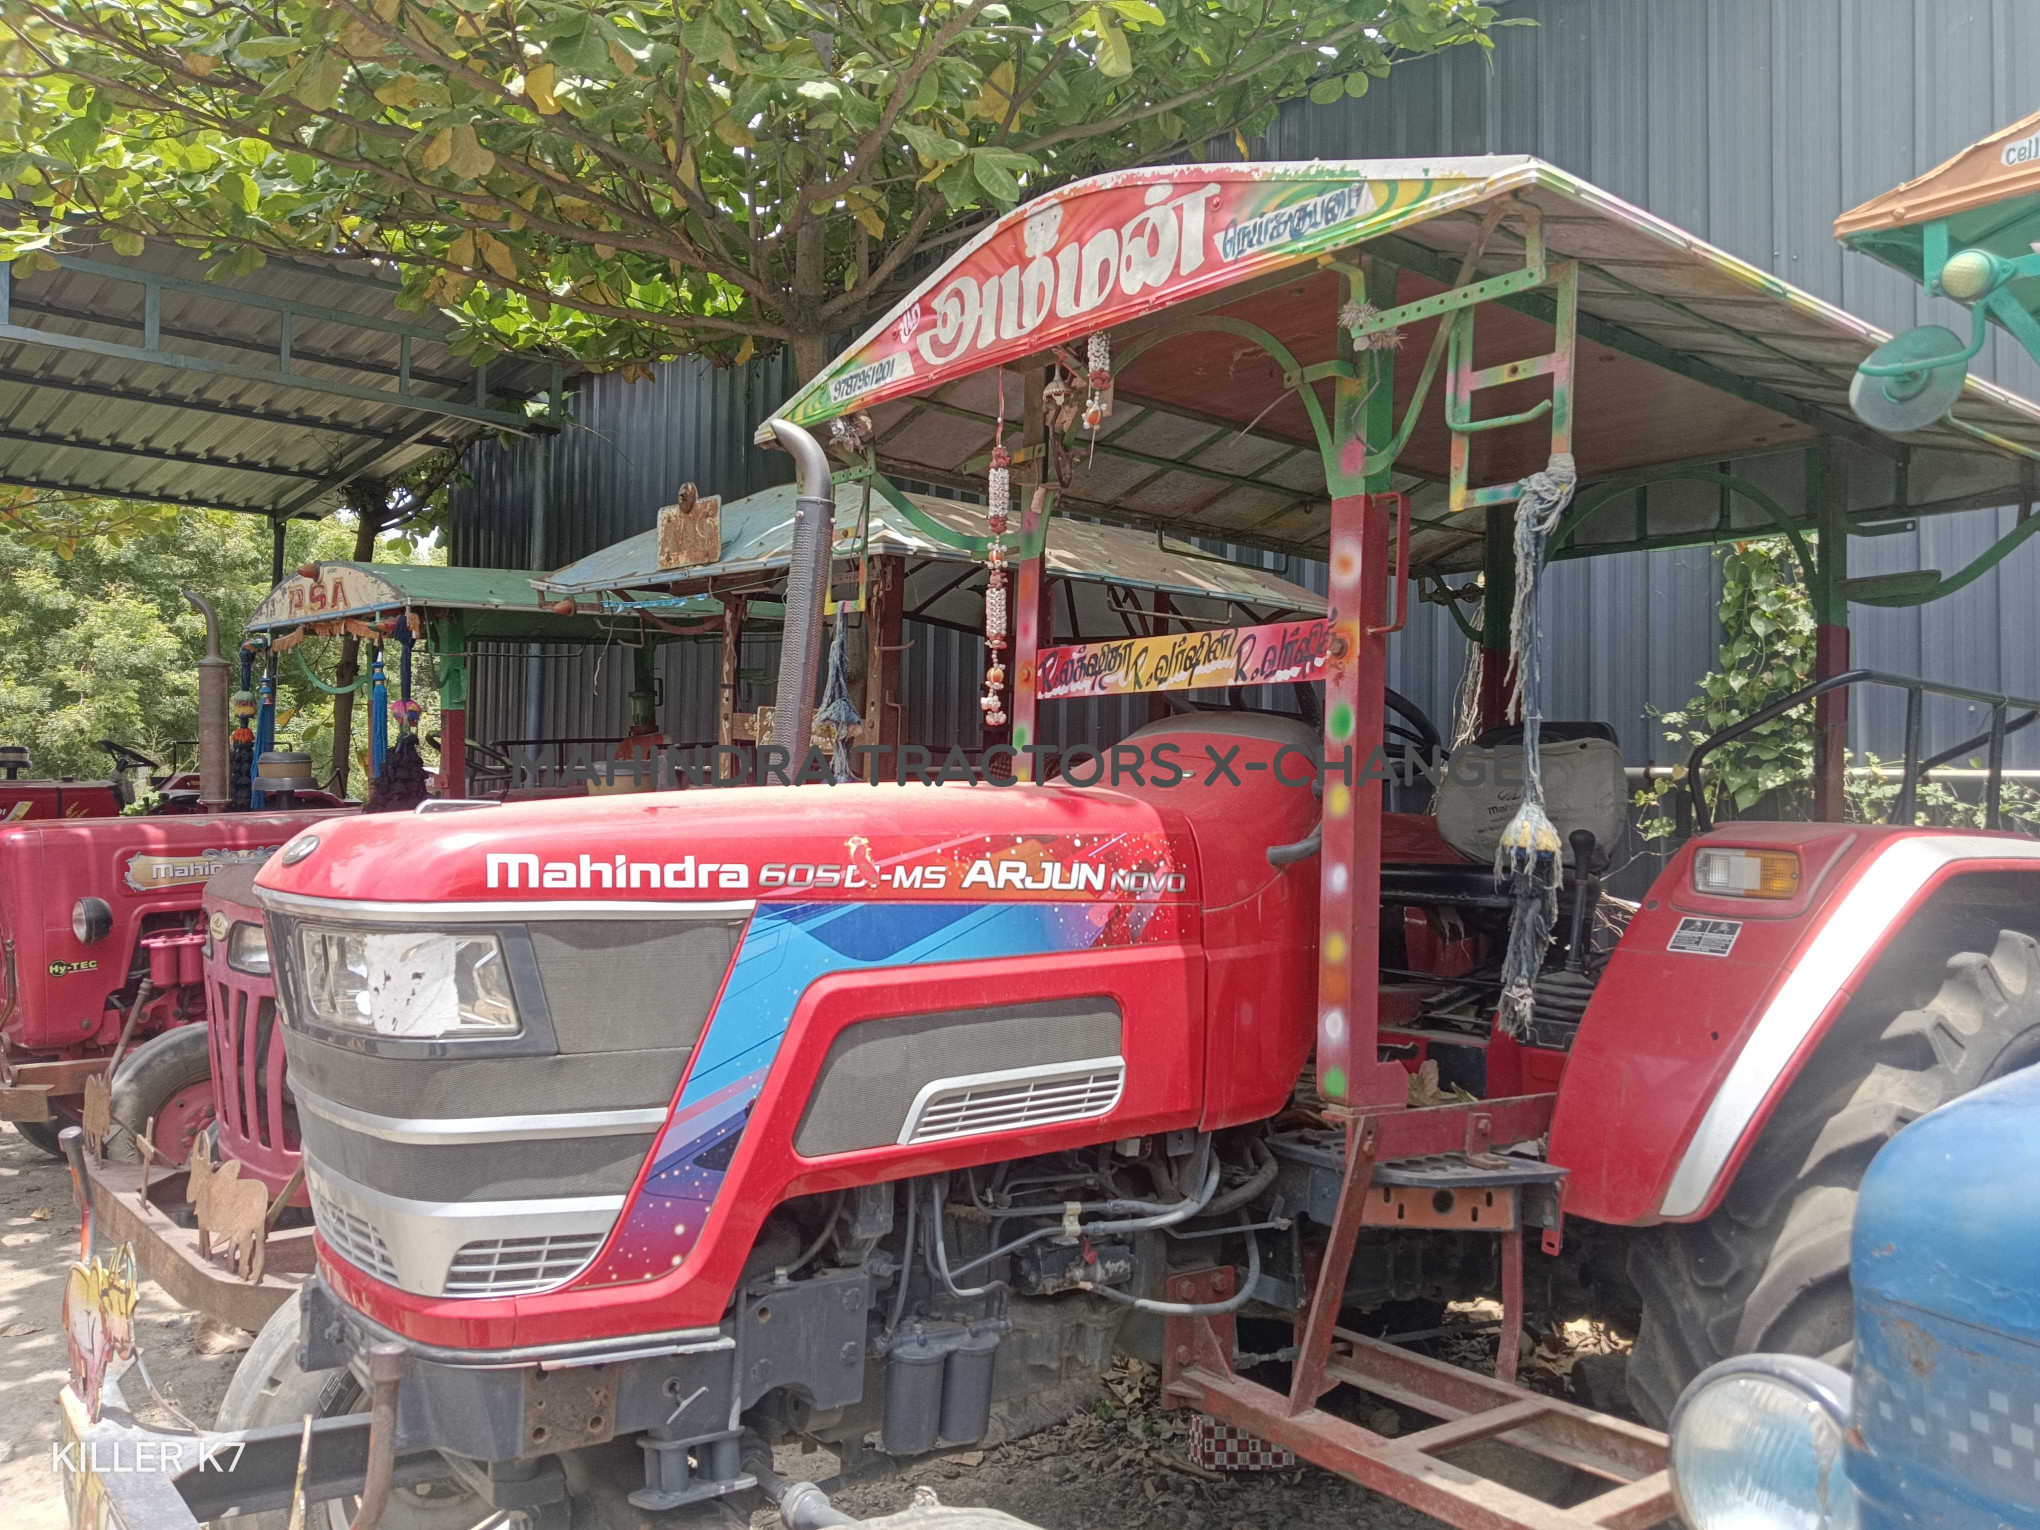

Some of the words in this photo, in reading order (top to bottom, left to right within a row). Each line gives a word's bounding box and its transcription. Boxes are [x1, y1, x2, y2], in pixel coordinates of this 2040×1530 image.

[916, 180, 1222, 365] அம்மன்
[152, 861, 225, 879] Mahin
[486, 853, 749, 889] Mahindra
[959, 859, 1106, 891] ARJUN
[1110, 870, 1186, 893] NOVO
[49, 960, 98, 974] Hy-TEC
